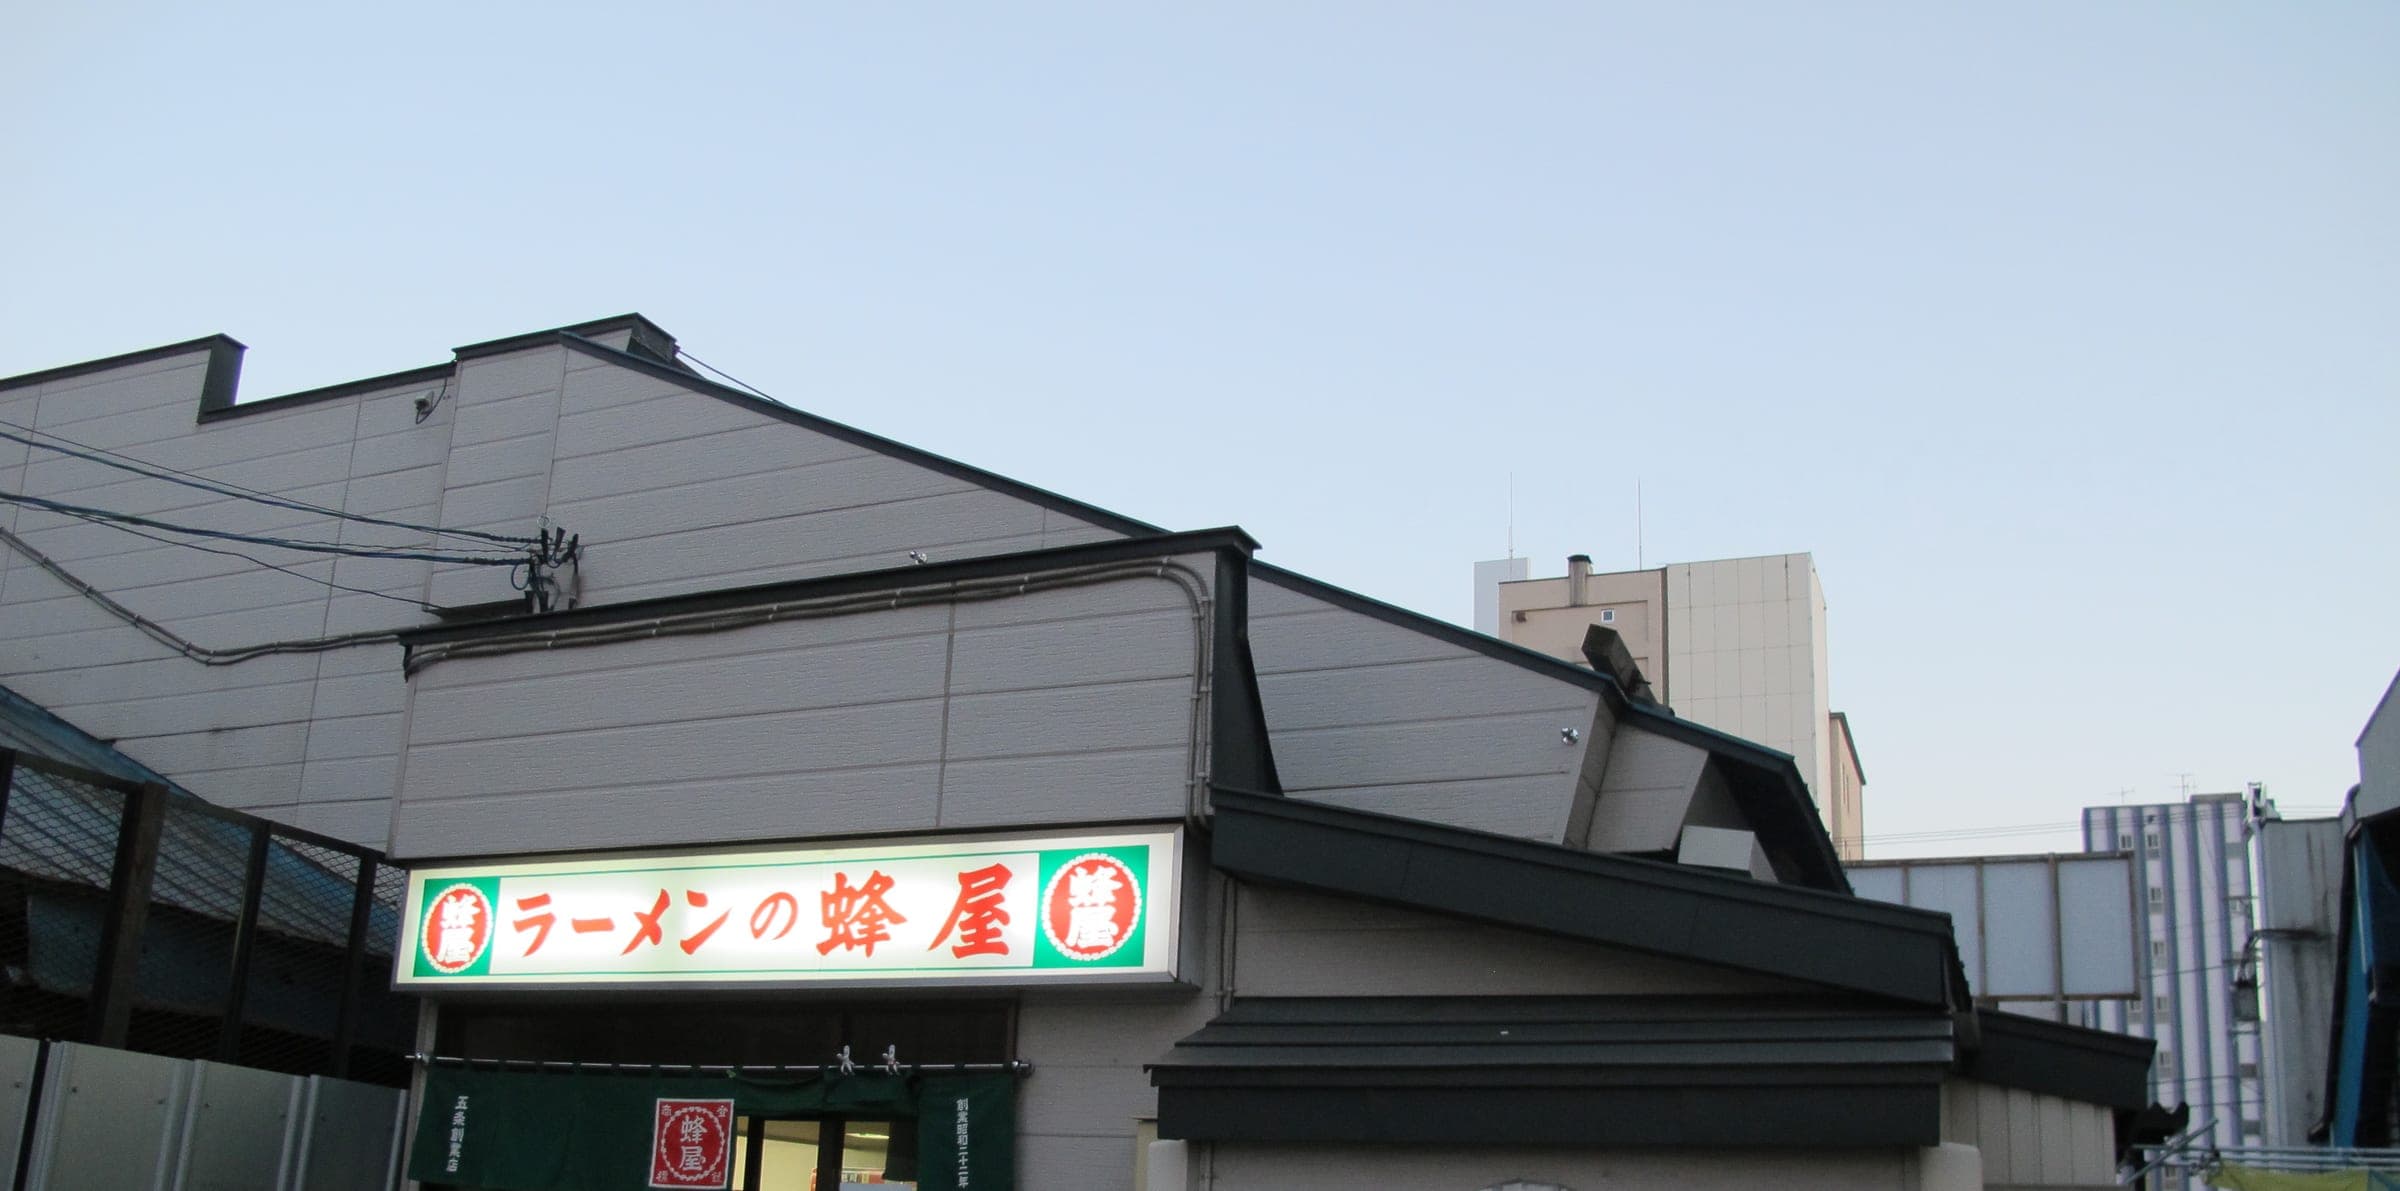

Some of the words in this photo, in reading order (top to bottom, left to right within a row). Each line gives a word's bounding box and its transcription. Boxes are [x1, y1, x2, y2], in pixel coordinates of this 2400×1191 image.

[512, 863, 1013, 960] ラーメンの蜂屋
[679, 1114, 708, 1171] 蜂屋
